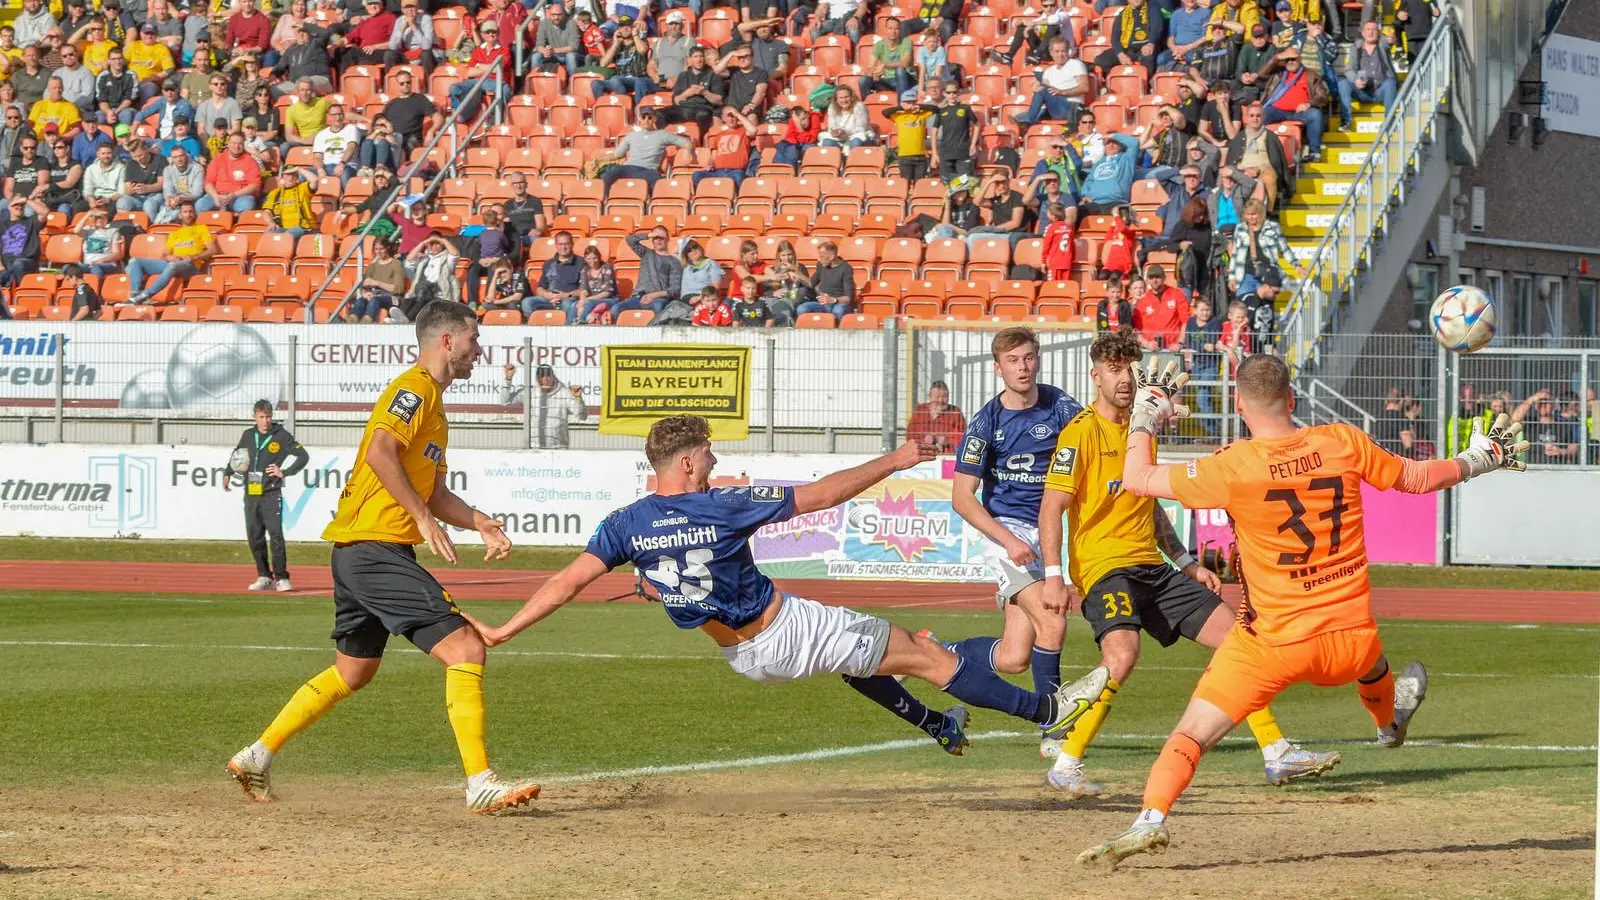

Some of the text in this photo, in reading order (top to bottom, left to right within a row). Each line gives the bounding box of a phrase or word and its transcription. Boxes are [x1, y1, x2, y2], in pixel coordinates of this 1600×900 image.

[311, 344, 418, 365] GEMEINS
[501, 346, 600, 366] TOPFOR
[617, 359, 738, 369] TEAM BANANENFLANKE
[631, 376, 723, 388] BAYREUTH
[391, 404, 411, 420] bwin
[621, 398, 644, 408] UND
[646, 398, 664, 408] DIE
[172, 459, 286, 488] Fens
[484, 467, 581, 479] www.therma.de
[1268, 451, 1323, 480] PETZOLD
[0, 479, 112, 502] therma
[511, 487, 612, 502] info@therma.de
[2, 502, 105, 512] Fensterbau GmbH
[652, 516, 689, 528] OLDENBURG
[862, 514, 948, 536] STURM
[1263, 475, 1349, 566] 37
[631, 524, 718, 551] Hasenhüttl
[1102, 591, 1134, 620] 33
